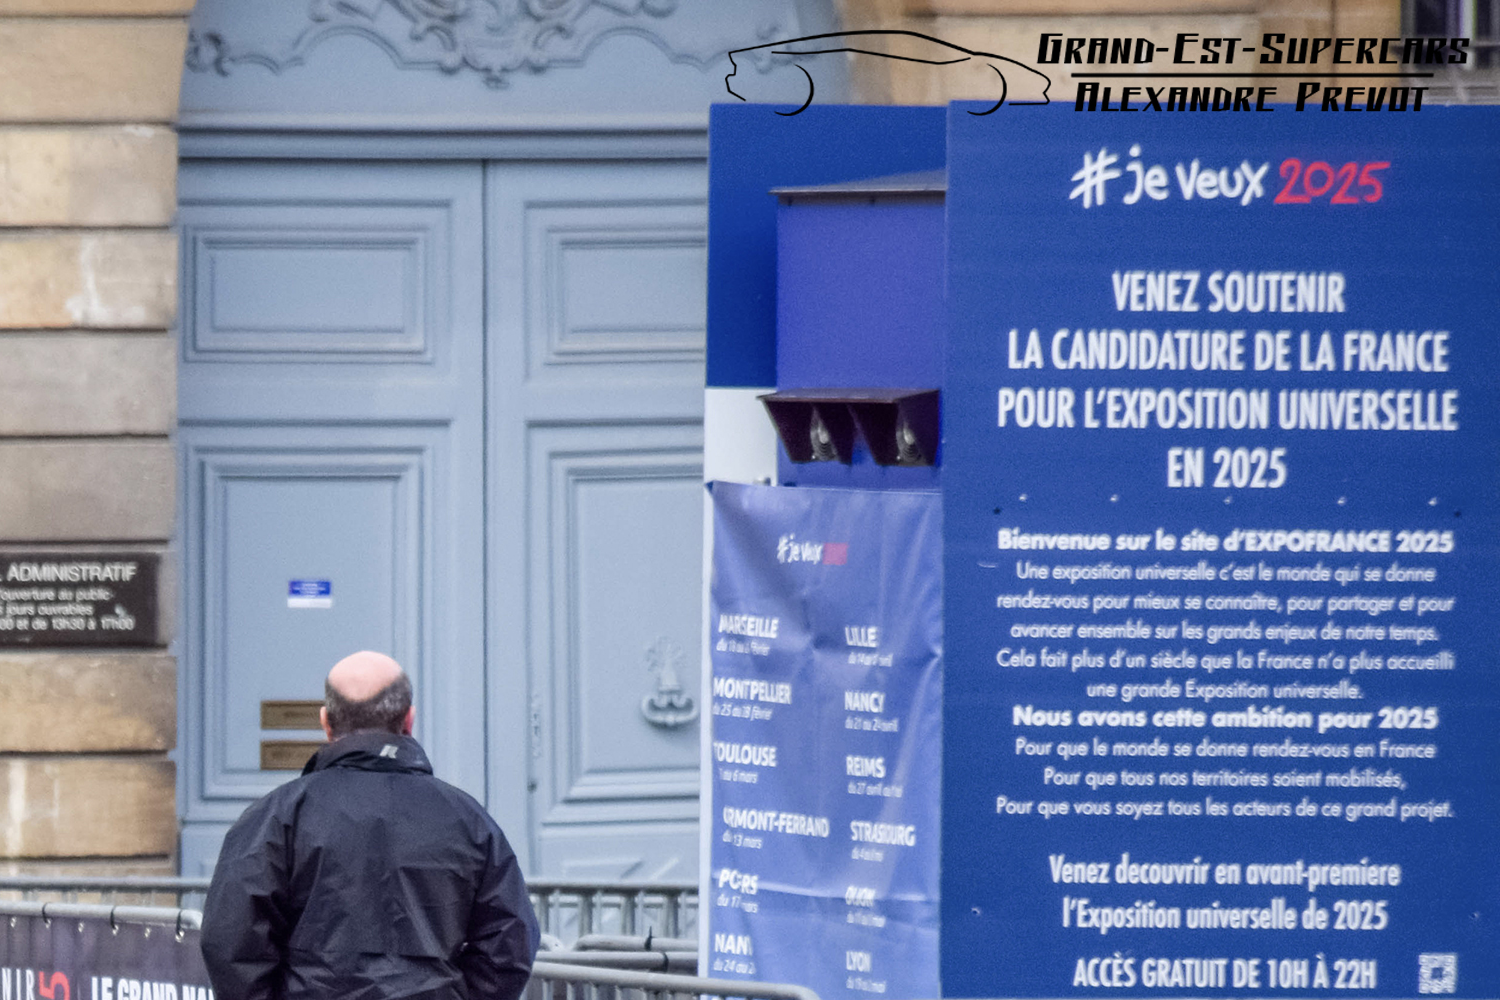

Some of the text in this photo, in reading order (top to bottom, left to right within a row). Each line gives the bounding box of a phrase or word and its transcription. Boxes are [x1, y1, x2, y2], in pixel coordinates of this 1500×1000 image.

[1273, 157, 1391, 204] 2025
[1111, 271, 1345, 313] VENEZ SOUTENIR
[1007, 329, 1449, 373] LA CANDIDATURE DE LA FRANCE
[997, 387, 1458, 431] POUR L'EXPOSITION UNIVERSELLE
[1167, 447, 1287, 489] EN 2025
[997, 527, 1112, 551] Bienvenue
[1115, 535, 1152, 551] sur
[1155, 528, 1177, 551] le
[1180, 529, 1220, 552] site
[1395, 531, 1455, 554] 2025
[6, 563, 137, 582] ADMINISTRATIF
[1016, 561, 1436, 585] Une exposition universelle c'est le monde qui se donne
[996, 589, 1091, 610] rendez-vous
[1092, 596, 1131, 614] pour
[1133, 594, 1181, 610] mieux
[1183, 596, 1203, 610] se
[1286, 597, 1324, 615] pour
[1327, 596, 1396, 616] partager
[1398, 597, 1416, 612] et
[1417, 598, 1455, 616] pour
[845, 626, 878, 647] LILLE
[1009, 620, 1439, 646] avancer ensemble sur les grands enjeux de notre temps.
[995, 648, 1455, 674] Cela fait plus d'un siècle que la France n'a plus accueilli
[845, 691, 885, 712] NANCY
[1086, 680, 1363, 703] une grande Exposition universelle.
[1012, 705, 1439, 734] Nous avons cette ambition pour 2025
[1015, 738, 1436, 761] Pour que le monde se donne rendez-vous en France
[846, 755, 886, 778] REIMS
[1043, 766, 1081, 786] Pour
[1084, 772, 1118, 791] que
[1120, 771, 1156, 787] tous
[1158, 773, 1189, 787] nos
[1191, 771, 1270, 787] territoires
[1272, 771, 1323, 788] soient
[996, 796, 1453, 822] Pour que vous soyez tous les acteurs de ce grand projet.
[1048, 855, 1111, 884] Venez
[1214, 864, 1242, 885] en
[1062, 896, 1388, 935] l'Exposition universelle de 2025
[846, 951, 871, 972] LYON
[1072, 952, 1377, 989] ACCÈS GRATUIT DE 10H À 22H
